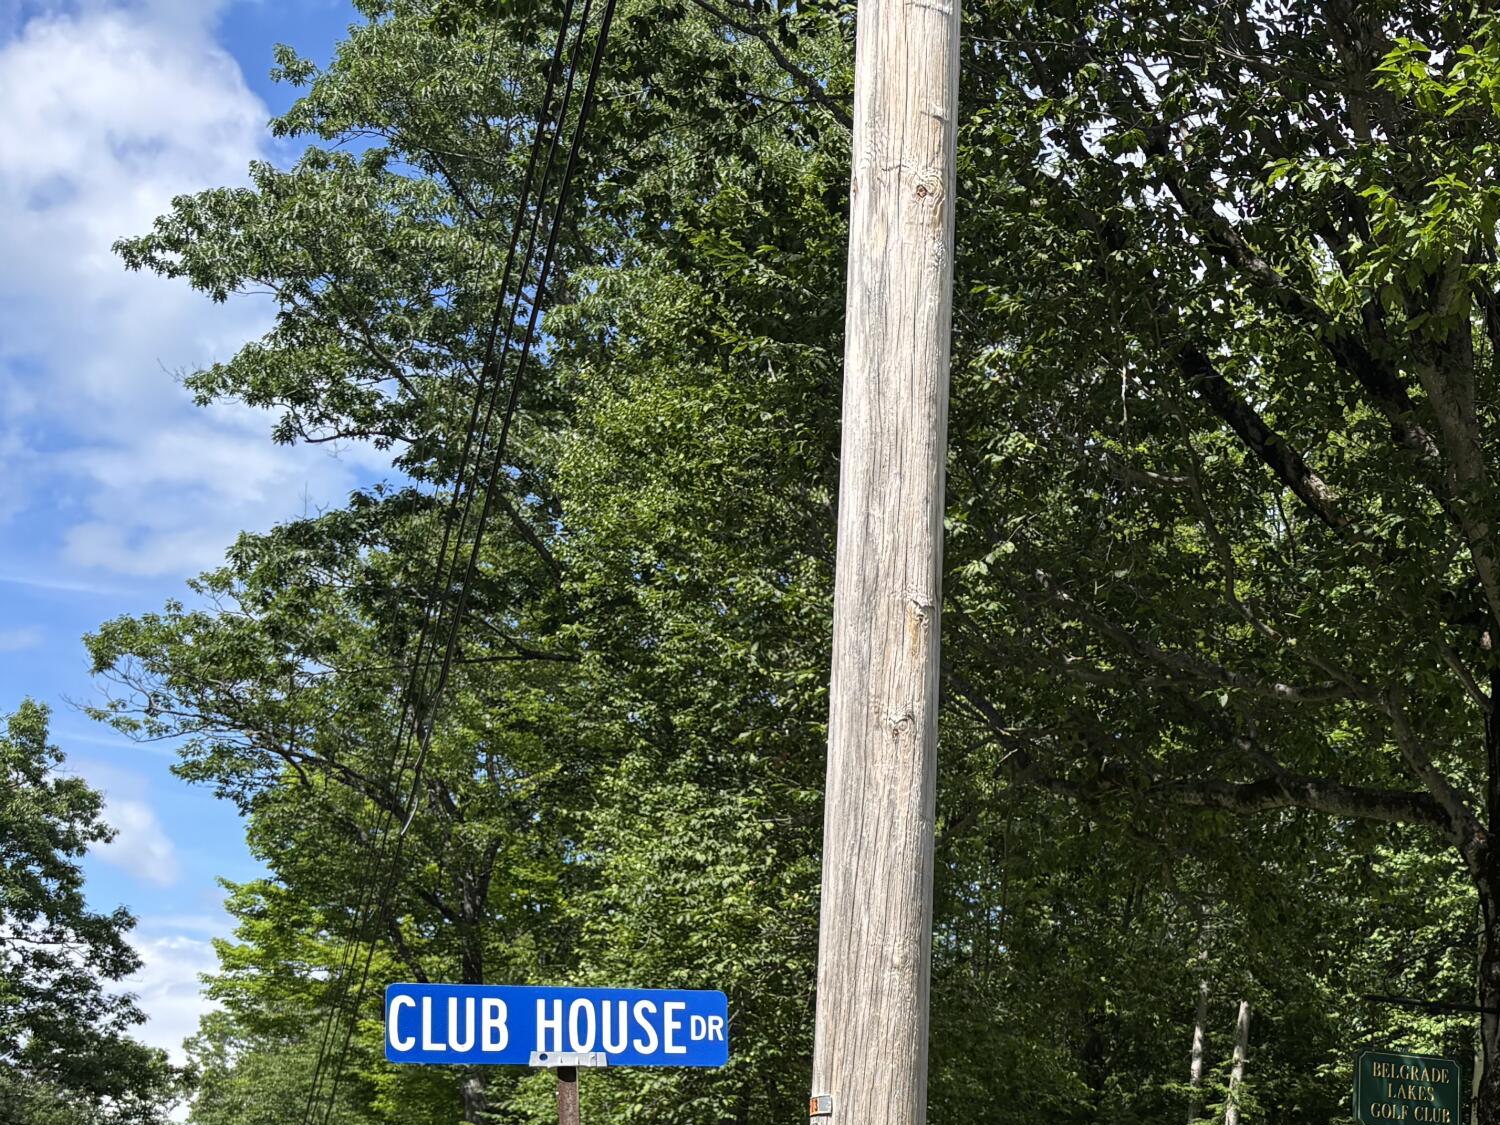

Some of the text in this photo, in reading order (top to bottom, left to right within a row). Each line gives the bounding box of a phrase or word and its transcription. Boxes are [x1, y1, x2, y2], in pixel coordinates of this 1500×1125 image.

[388, 995, 725, 1055] CLUB HOUSE DR
[1373, 1062, 1450, 1083] BELGRADE
[1388, 1083, 1435, 1101] LAKES
[1370, 1103, 1450, 1123] GOLF CLUB
